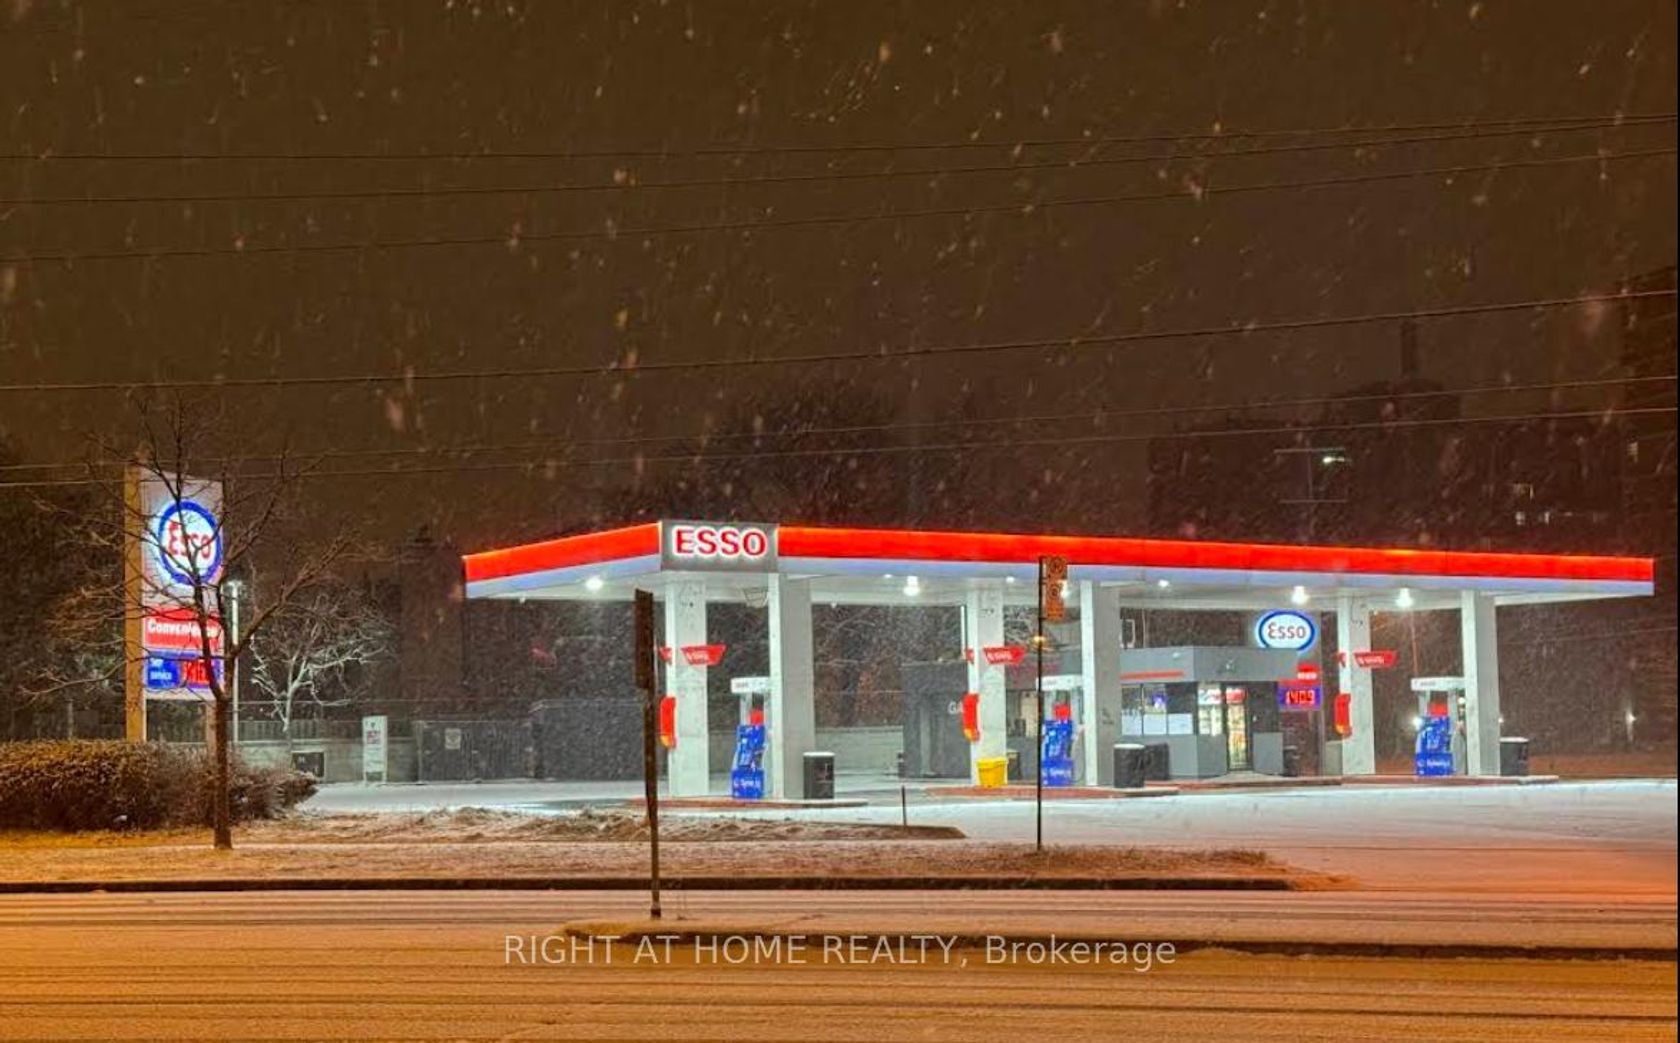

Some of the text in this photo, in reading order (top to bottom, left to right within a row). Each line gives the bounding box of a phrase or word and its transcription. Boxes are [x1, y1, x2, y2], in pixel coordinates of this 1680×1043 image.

[674, 527, 768, 557] ESSO
[147, 618, 220, 639] Conveniece
[1267, 622, 1307, 640] Esso
